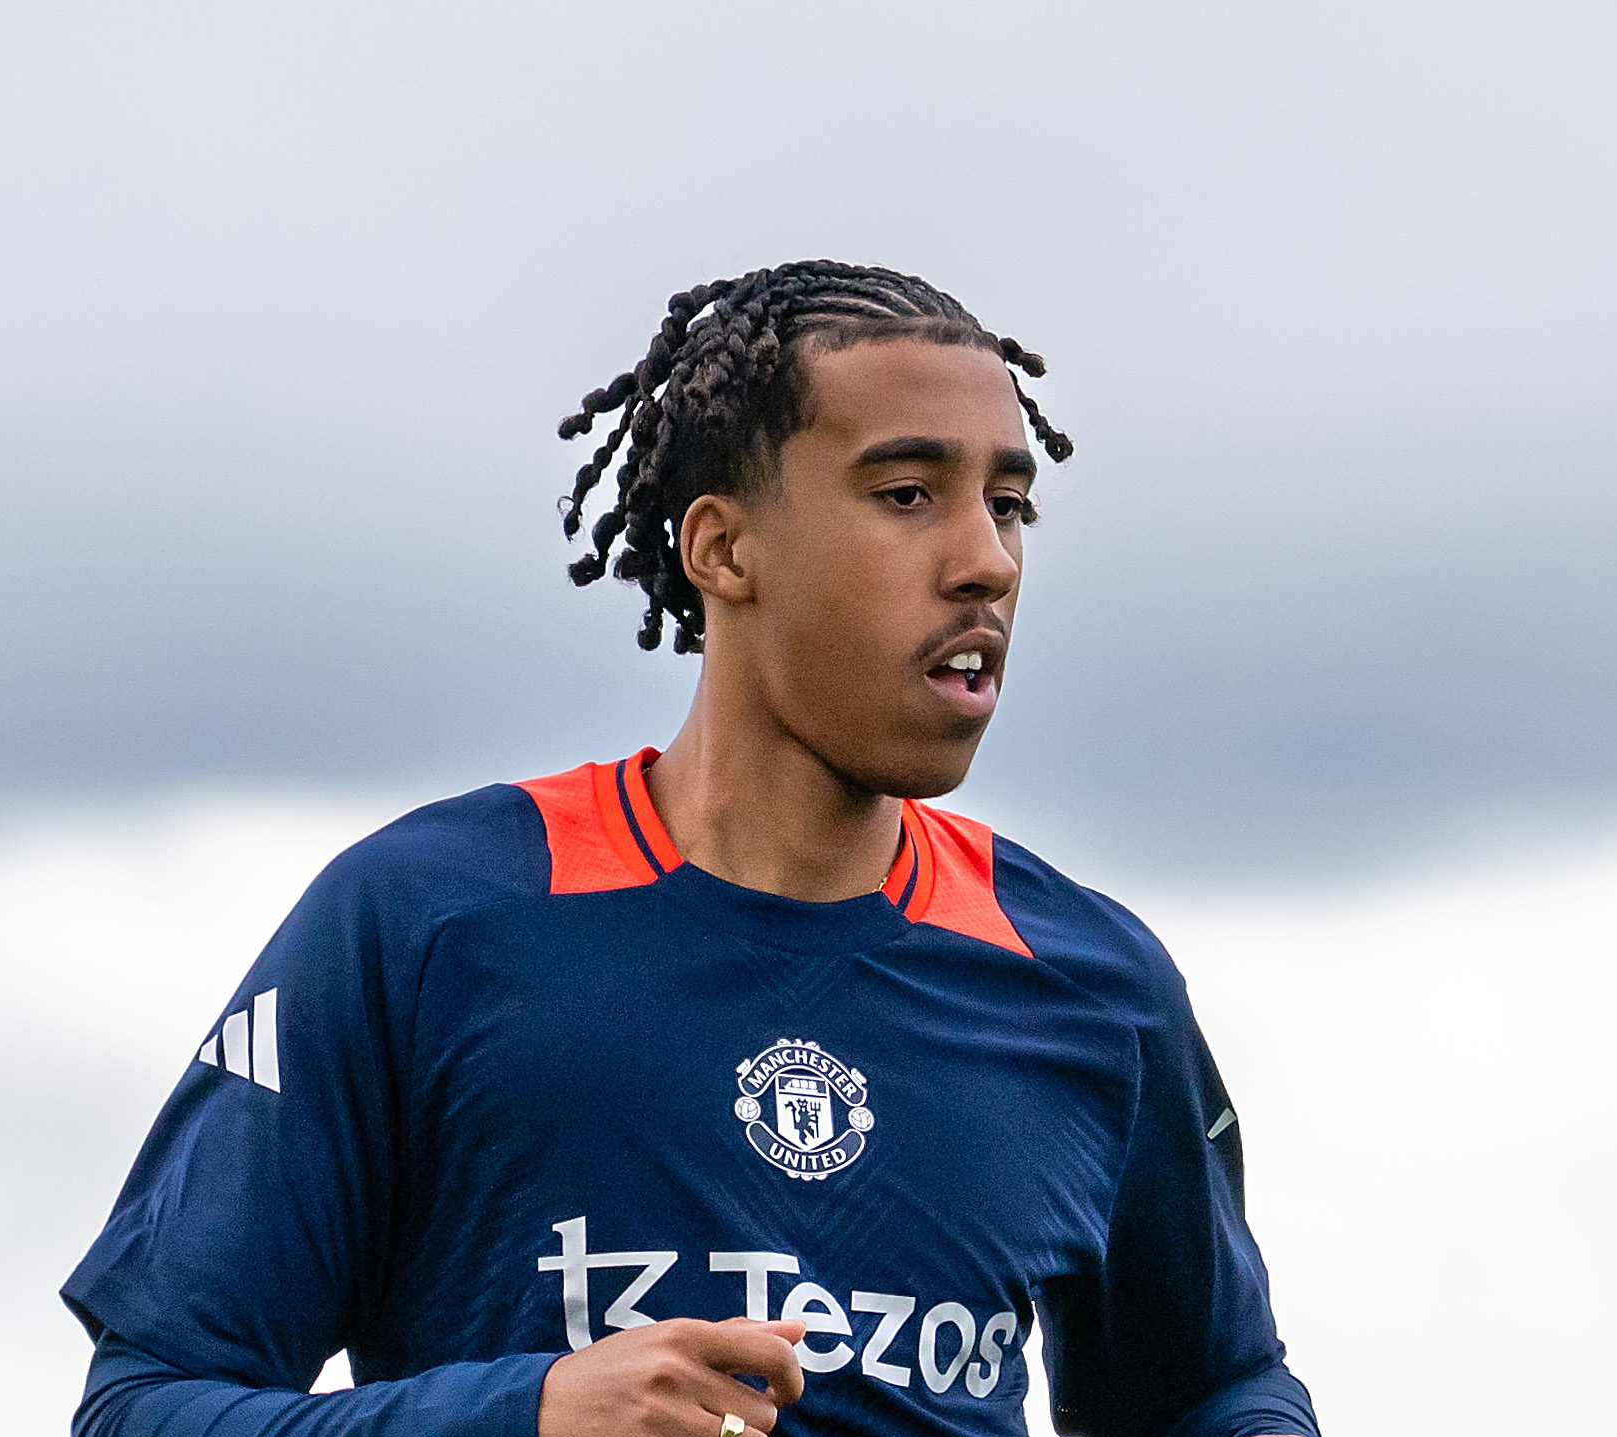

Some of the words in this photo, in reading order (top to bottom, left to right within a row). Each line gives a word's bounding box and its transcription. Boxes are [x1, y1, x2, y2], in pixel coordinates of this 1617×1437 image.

[747, 1049, 858, 1099] MANCHESTER
[769, 1142, 847, 1170] UNITED
[708, 1251, 1018, 1399] Tezos
